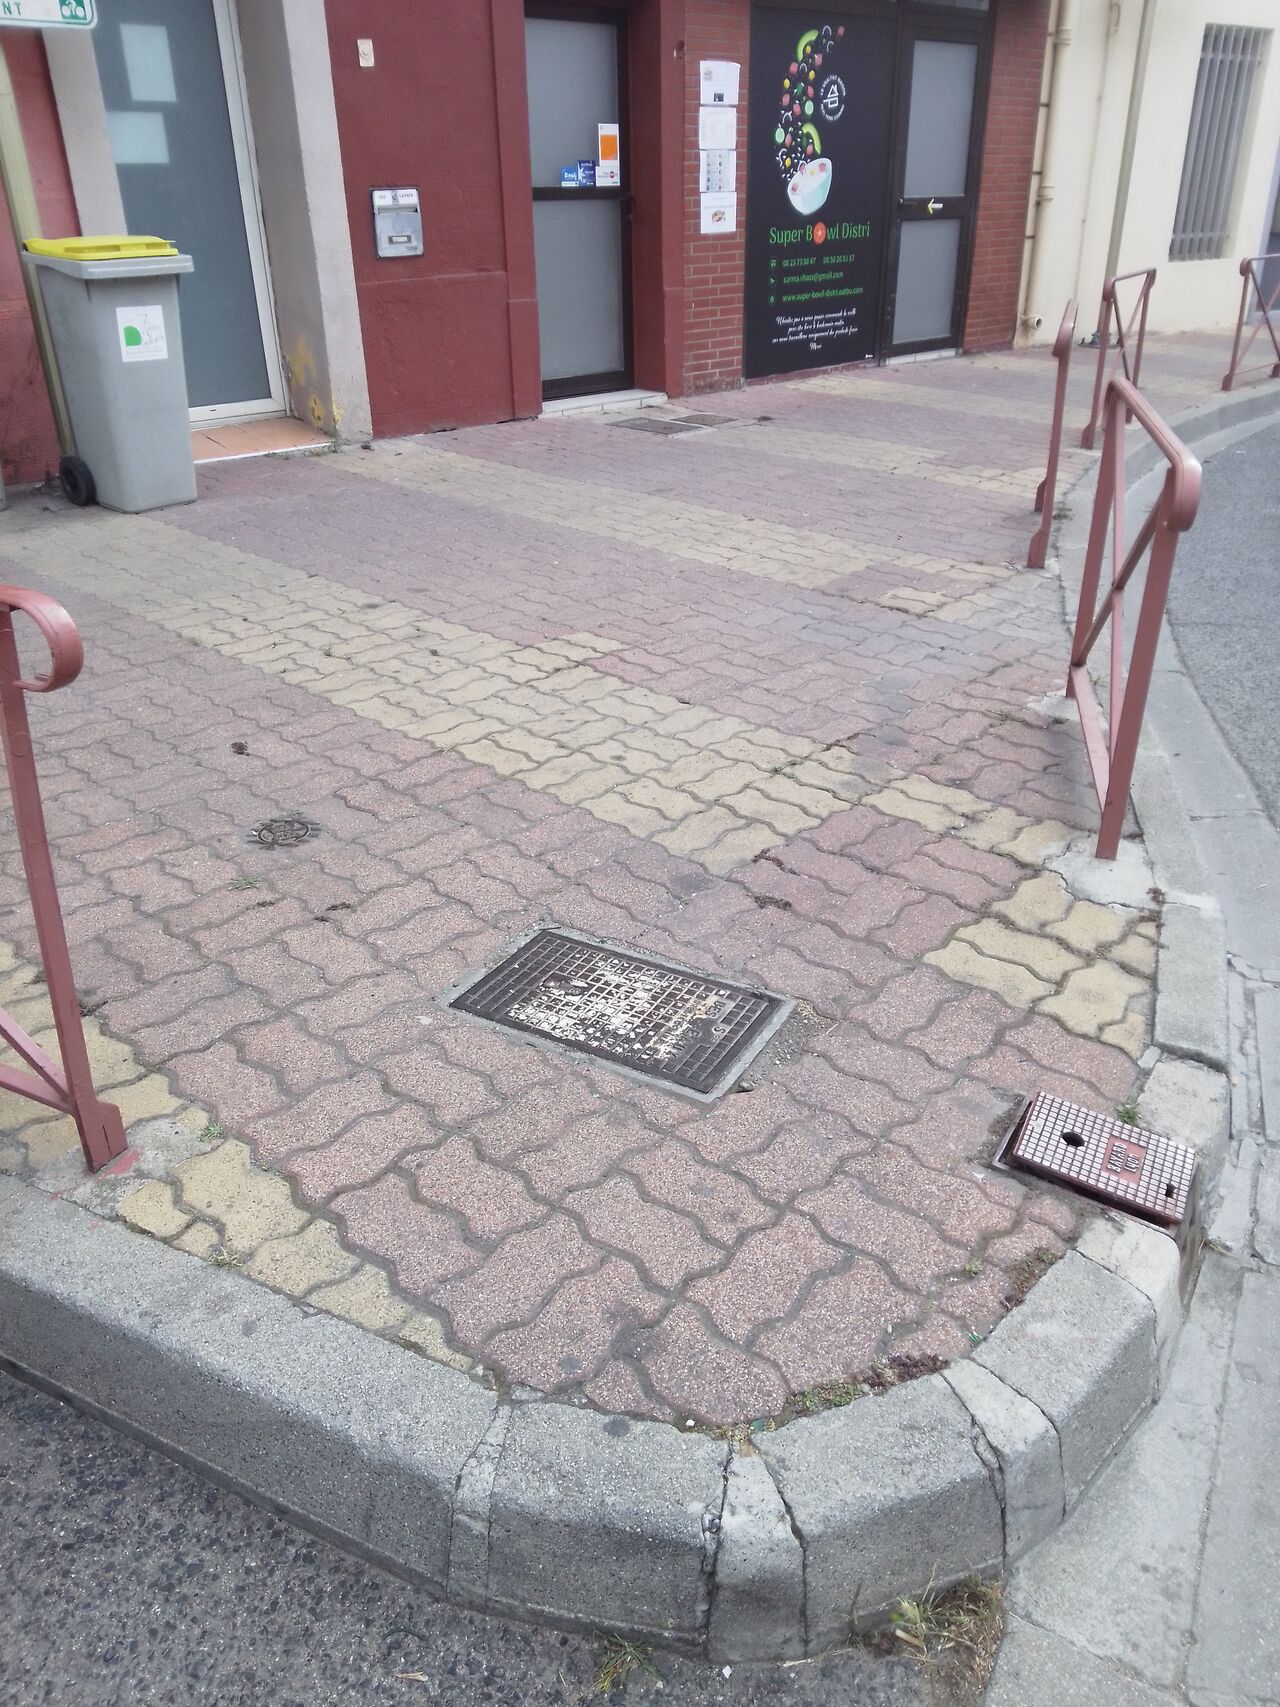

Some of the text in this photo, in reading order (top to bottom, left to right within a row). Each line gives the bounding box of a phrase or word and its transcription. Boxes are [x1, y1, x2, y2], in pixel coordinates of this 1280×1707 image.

[769, 226, 803, 247] Super
[841, 221, 870, 239] Distri
[1107, 1142, 1127, 1173] BAYARD
